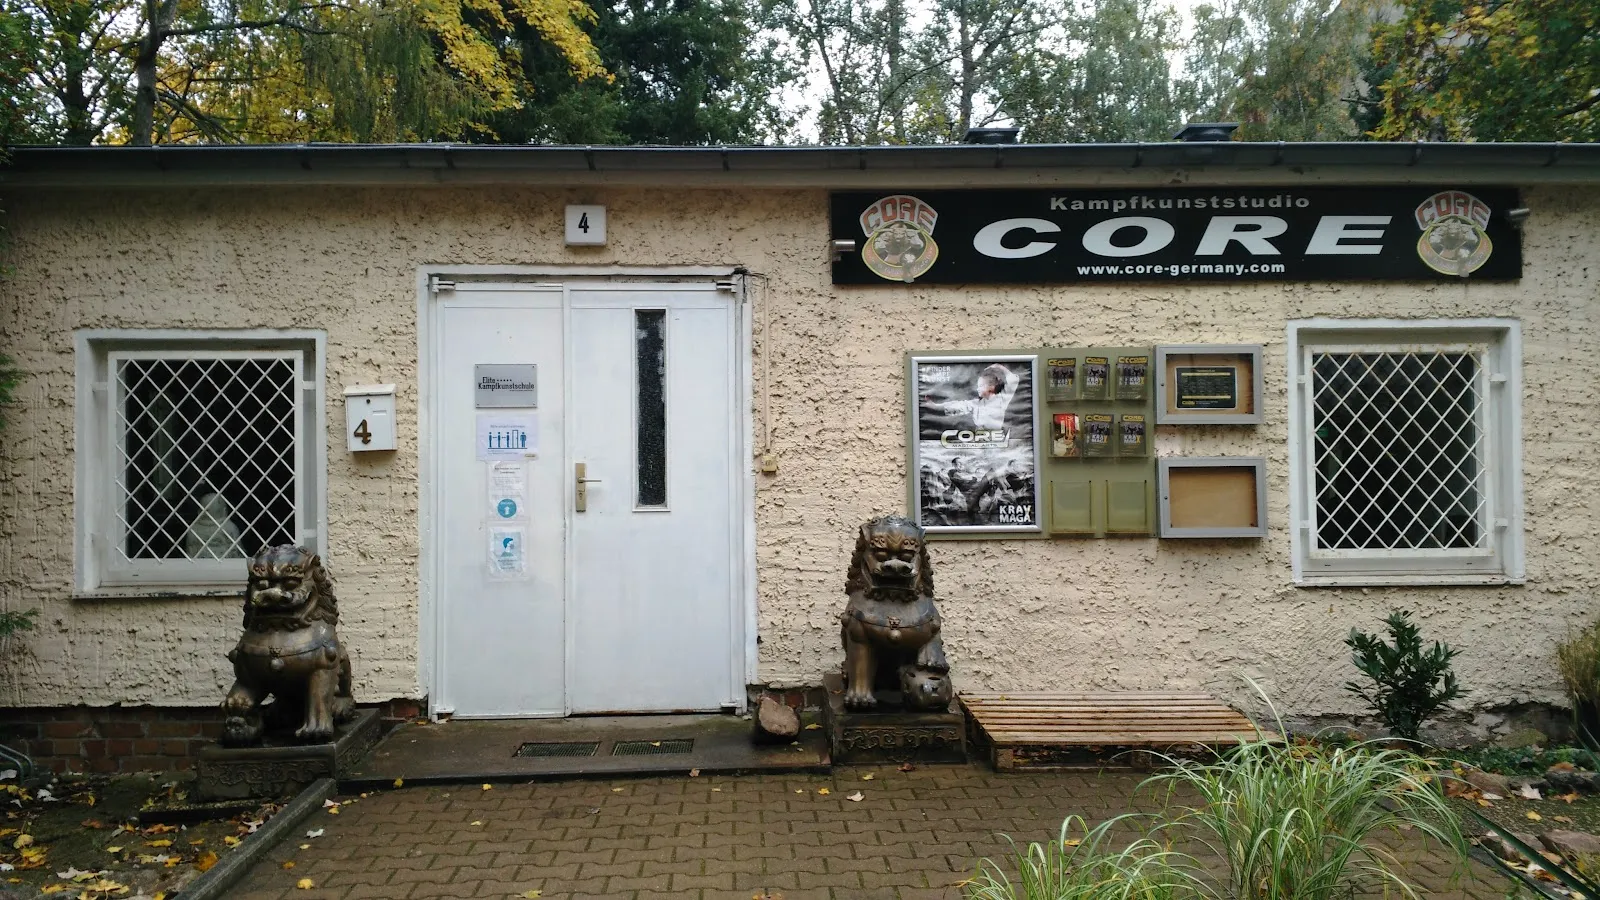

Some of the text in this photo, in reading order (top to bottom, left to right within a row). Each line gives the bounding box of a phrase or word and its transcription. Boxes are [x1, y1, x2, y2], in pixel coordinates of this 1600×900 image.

[1050, 194, 1311, 212] Kampfkunststudio
[1417, 192, 1489, 230] CORE
[578, 212, 590, 234] 4
[862, 197, 937, 235] CORE
[972, 216, 1393, 259] CORE
[1077, 263, 1286, 277] www.core-germany.com
[477, 382, 535, 391] Kampfkunstschule
[482, 376, 496, 384] Elite
[353, 419, 372, 445] 4
[941, 429, 1008, 447] CORE
[999, 505, 1032, 515] KRAV
[999, 513, 1032, 523] MAGA
